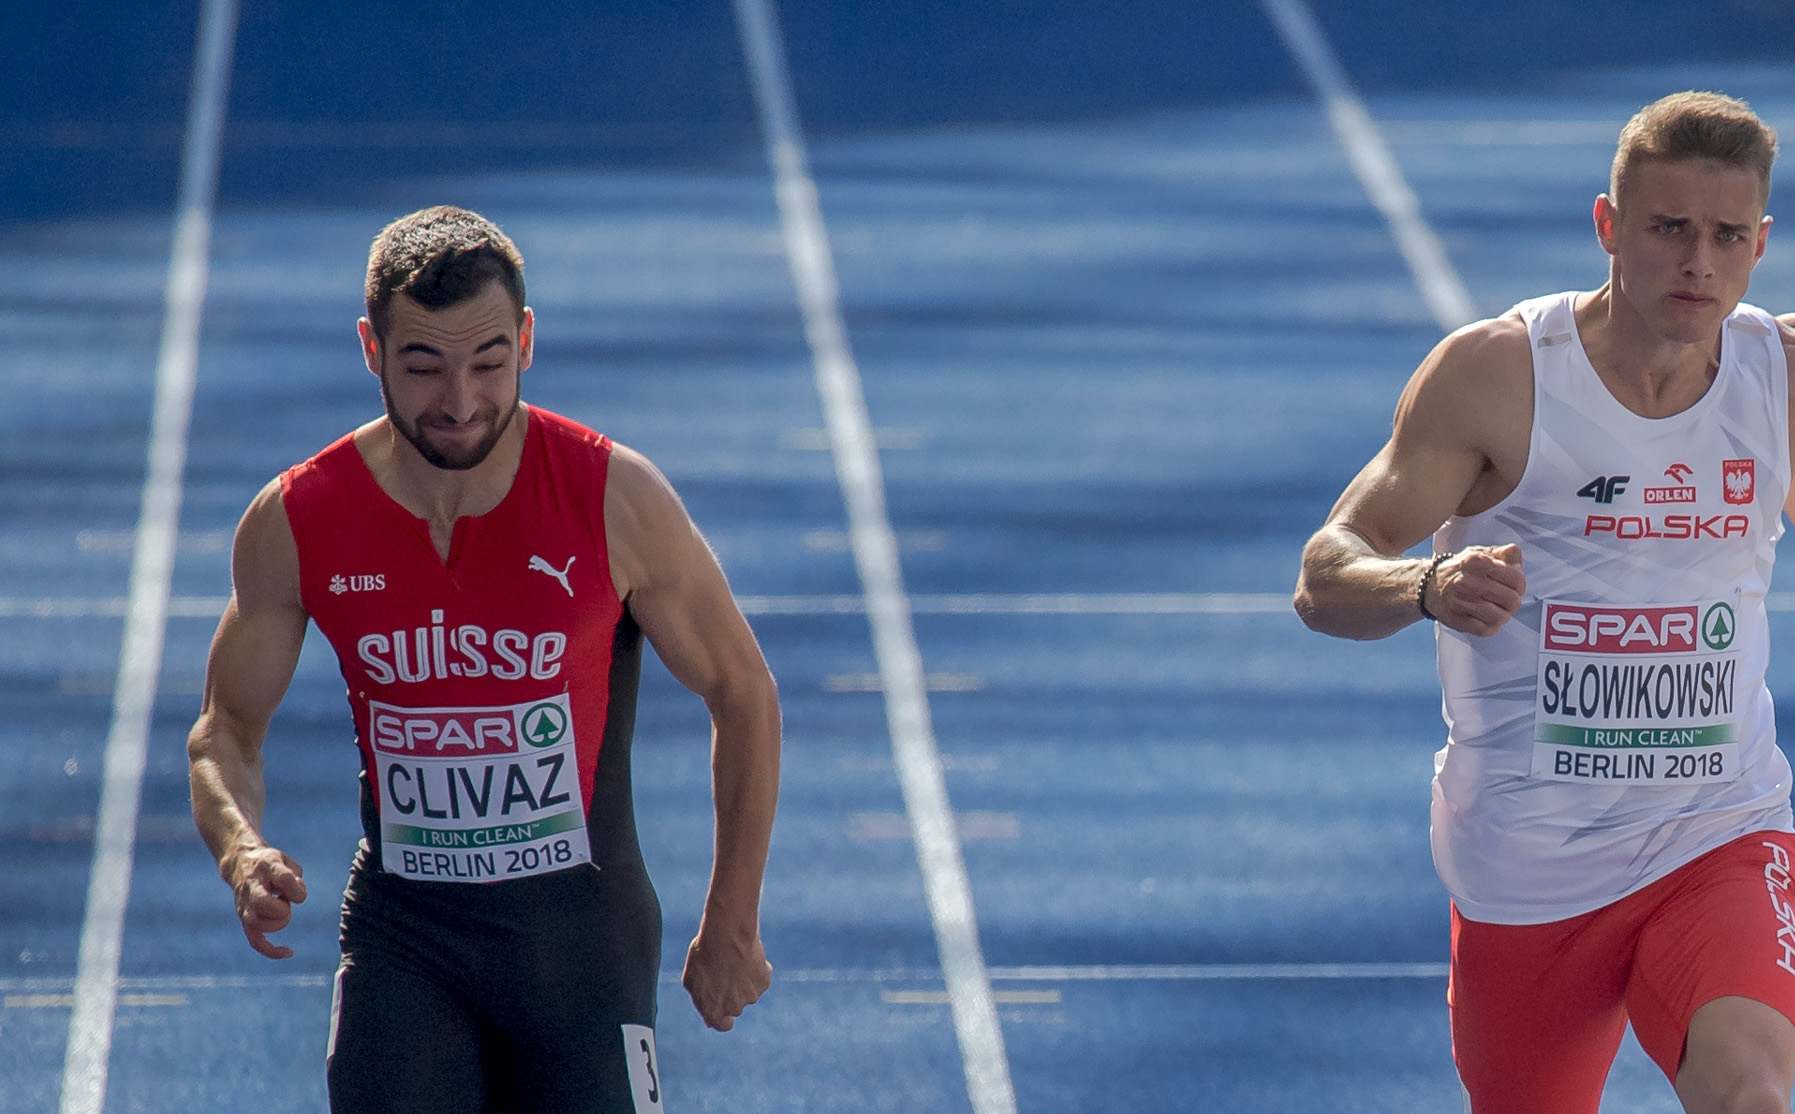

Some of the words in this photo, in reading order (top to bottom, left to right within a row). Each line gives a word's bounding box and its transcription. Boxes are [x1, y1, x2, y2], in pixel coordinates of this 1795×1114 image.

[1577, 476, 1630, 504] 4F
[1646, 489, 1693, 501] ORLEN
[1584, 515, 1749, 540] POLSKA
[350, 574, 386, 592] UBS
[1550, 612, 1695, 647] SPAR
[357, 609, 568, 685] suisse
[1542, 659, 1736, 720] SŁOWIKOWSKI
[375, 717, 516, 751] SPAR
[1595, 729, 1634, 746] RUN
[1554, 750, 1655, 780] BERLIN
[1664, 752, 1723, 779] 2018
[387, 752, 571, 820] CLIVAZ
[431, 829, 468, 846] RUN
[402, 849, 496, 878] BERLIN
[505, 839, 572, 874] 2018
[639, 1038, 660, 1104] 3
